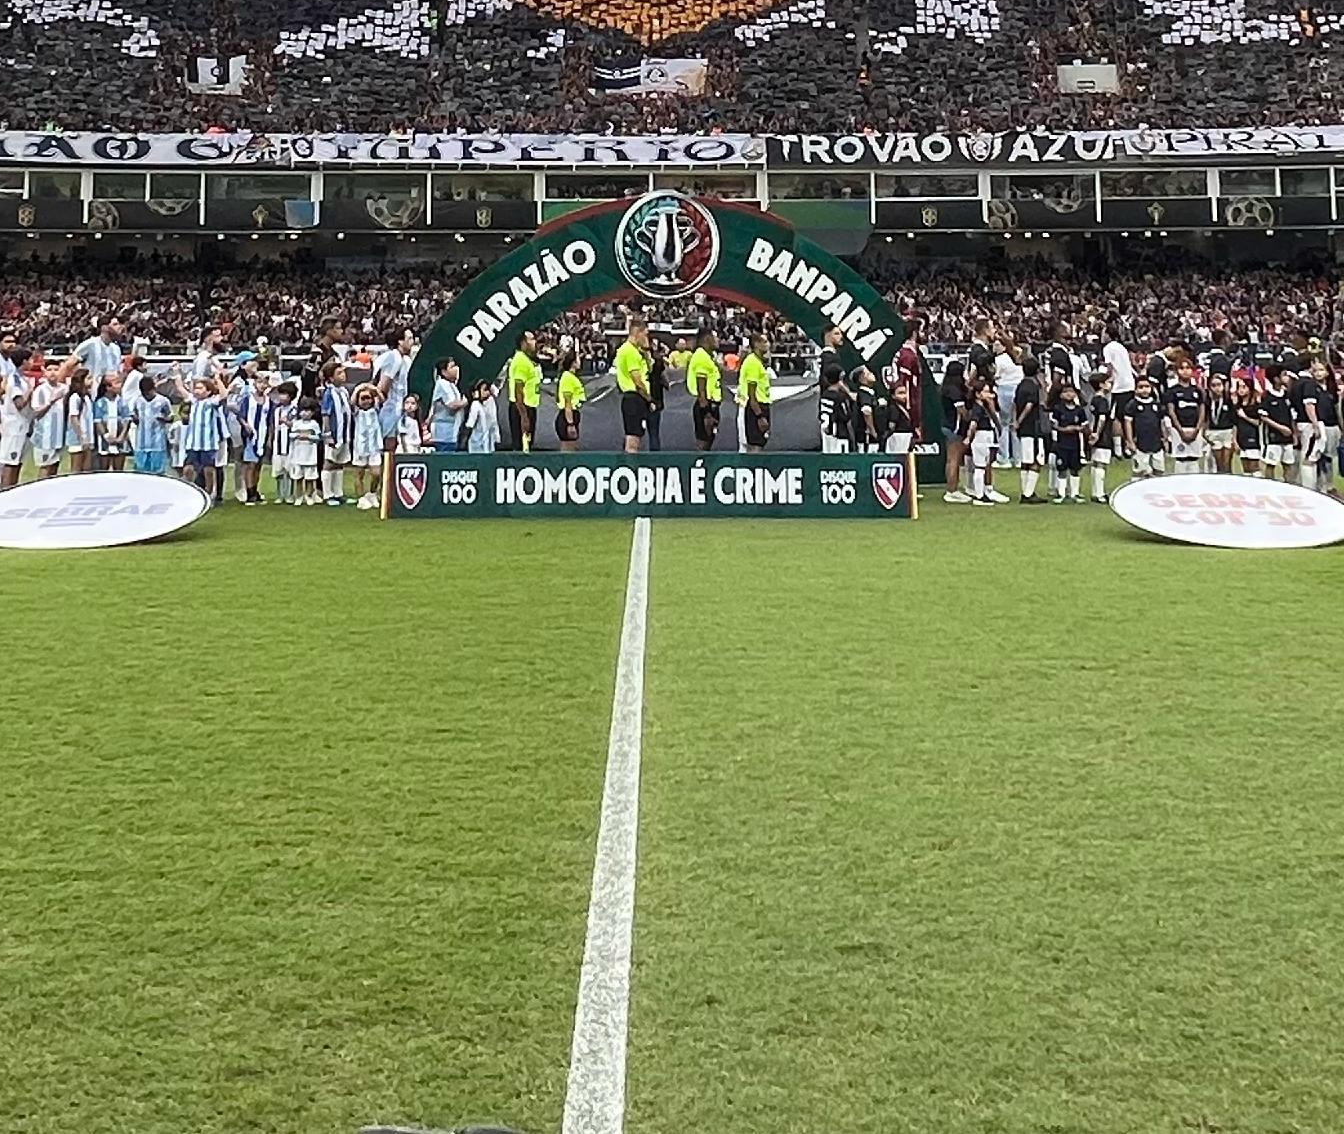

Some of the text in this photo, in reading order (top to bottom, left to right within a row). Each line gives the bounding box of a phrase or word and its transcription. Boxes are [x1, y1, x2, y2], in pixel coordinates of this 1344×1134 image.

[456, 237, 894, 362] PARAZÃO BANPARÁ
[441, 470, 478, 485] DISQUE
[495, 459, 804, 505] HOMOFOBIA É CRIME
[820, 470, 857, 484] DISQUE
[441, 484, 477, 504] 100
[820, 484, 856, 504] 100
